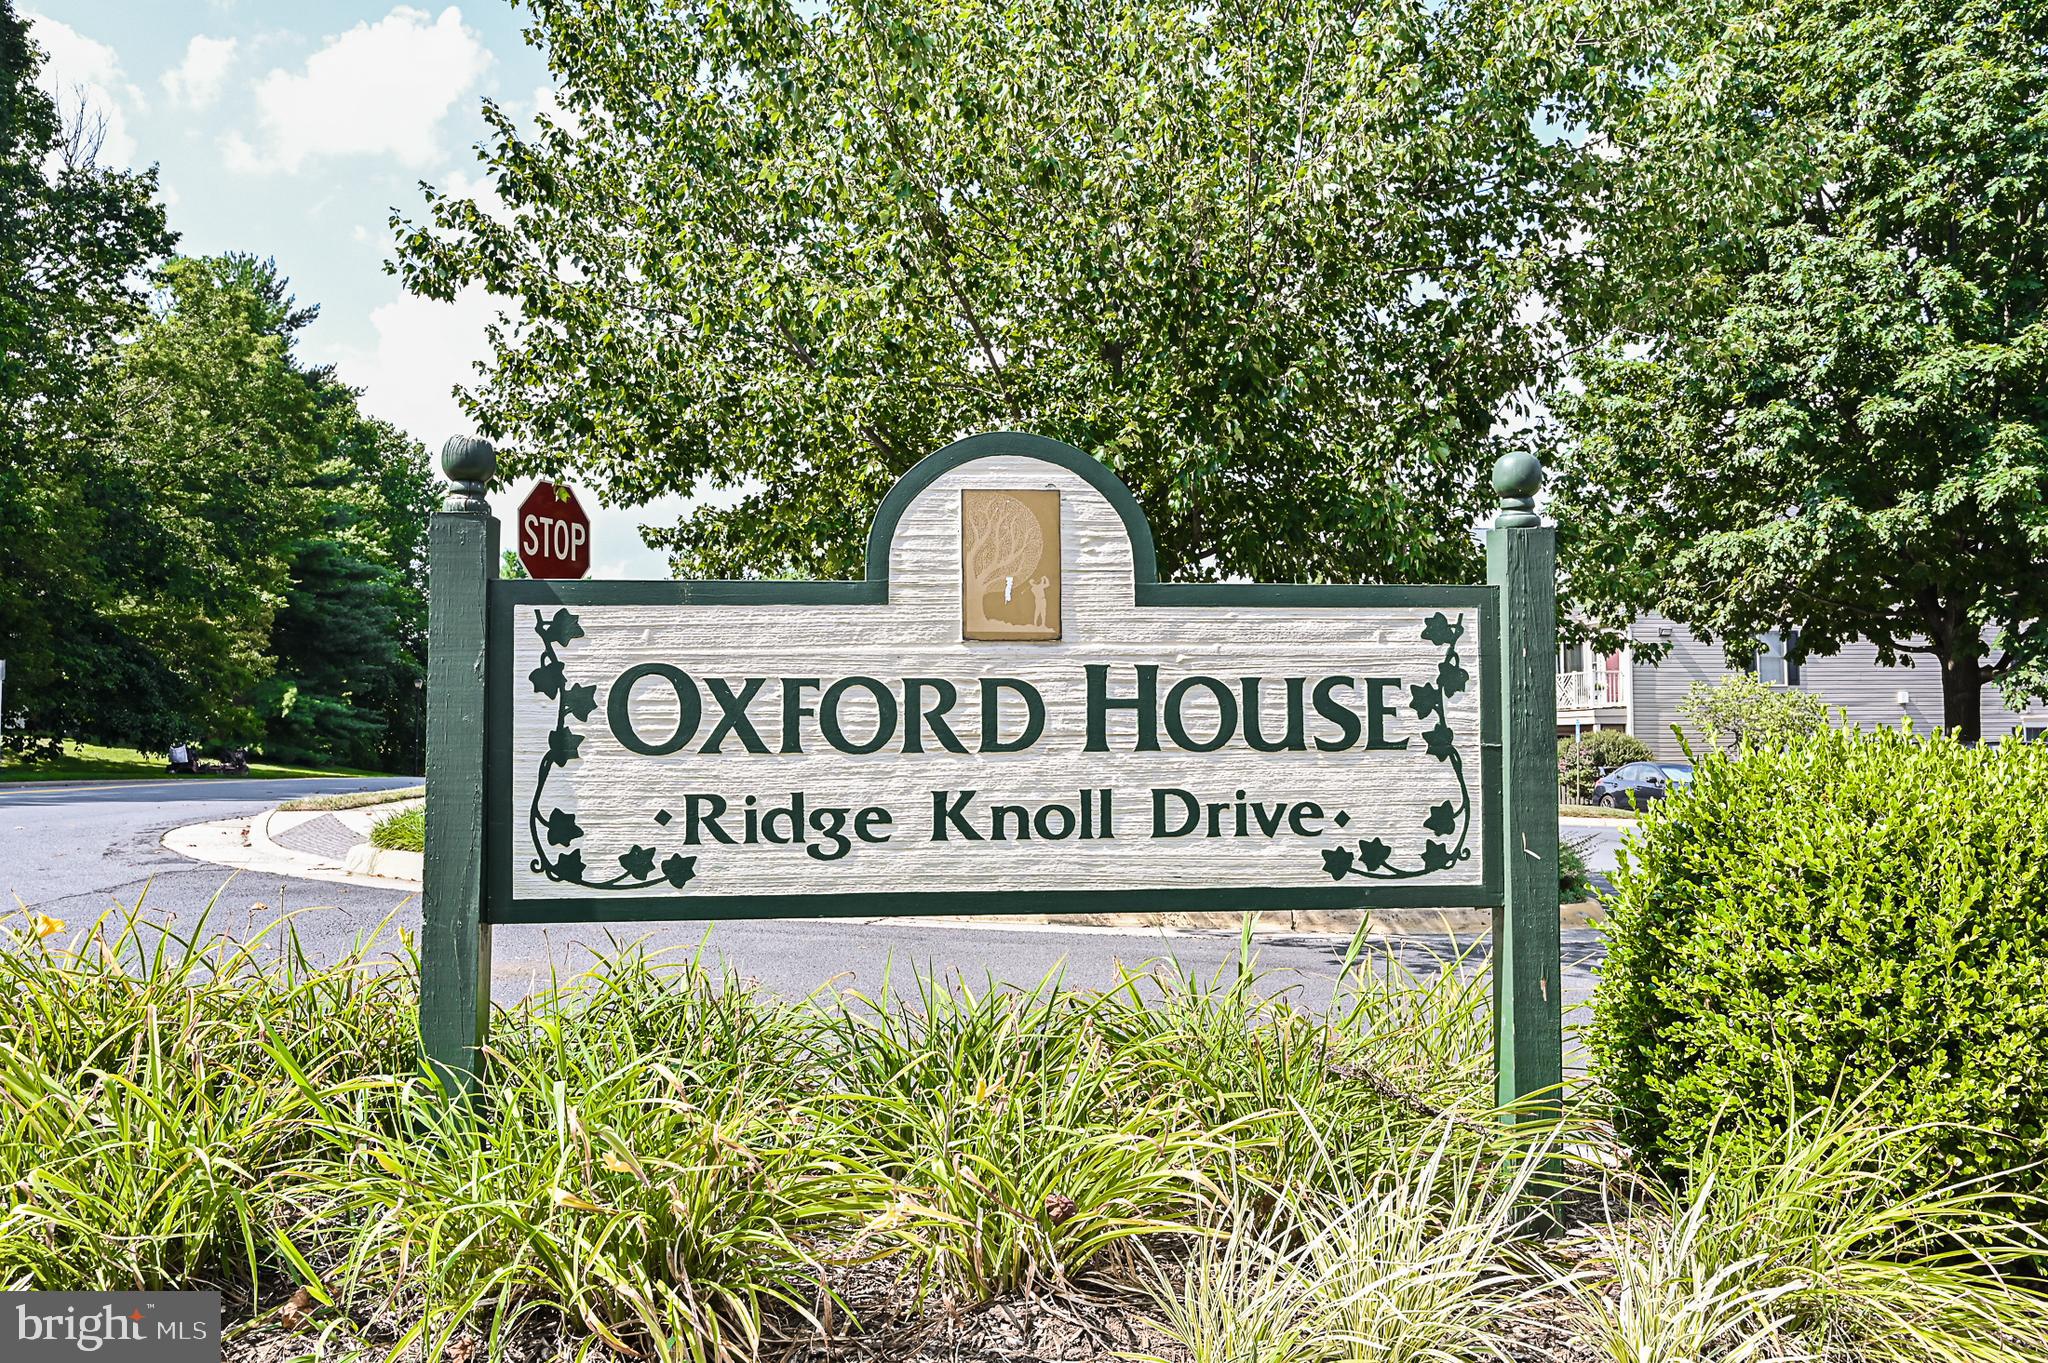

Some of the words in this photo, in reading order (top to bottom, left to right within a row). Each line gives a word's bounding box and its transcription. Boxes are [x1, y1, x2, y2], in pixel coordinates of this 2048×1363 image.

[523, 513, 586, 562] STOP
[606, 662, 1046, 756] OXFORD
[1083, 664, 1411, 753] HOUSE
[683, 791, 893, 861] Ridge
[930, 788, 1115, 842] Knoll
[1150, 789, 1324, 838] Drive
